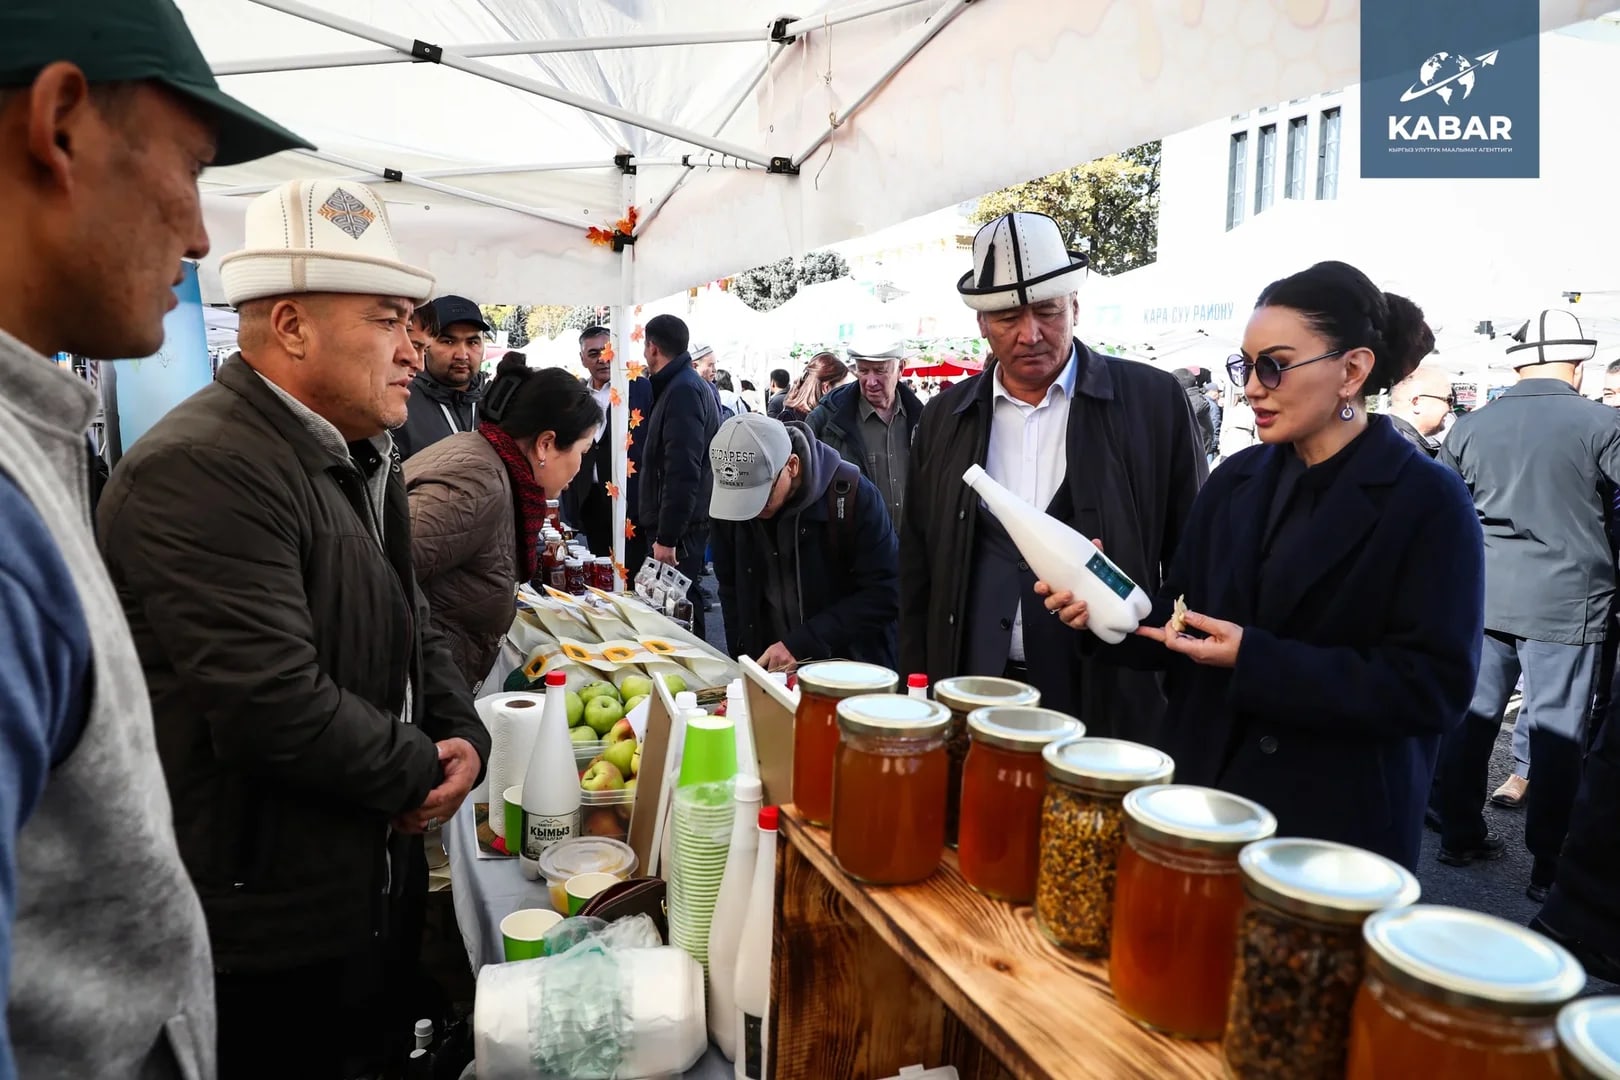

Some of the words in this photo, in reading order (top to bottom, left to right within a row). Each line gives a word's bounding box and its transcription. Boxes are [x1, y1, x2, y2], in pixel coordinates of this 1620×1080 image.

[1143, 307, 1168, 325] КАРА
[1171, 305, 1191, 324] СУУ
[711, 448, 755, 463] BUDAPEST
[530, 826, 570, 836] КЫМЫЗ
